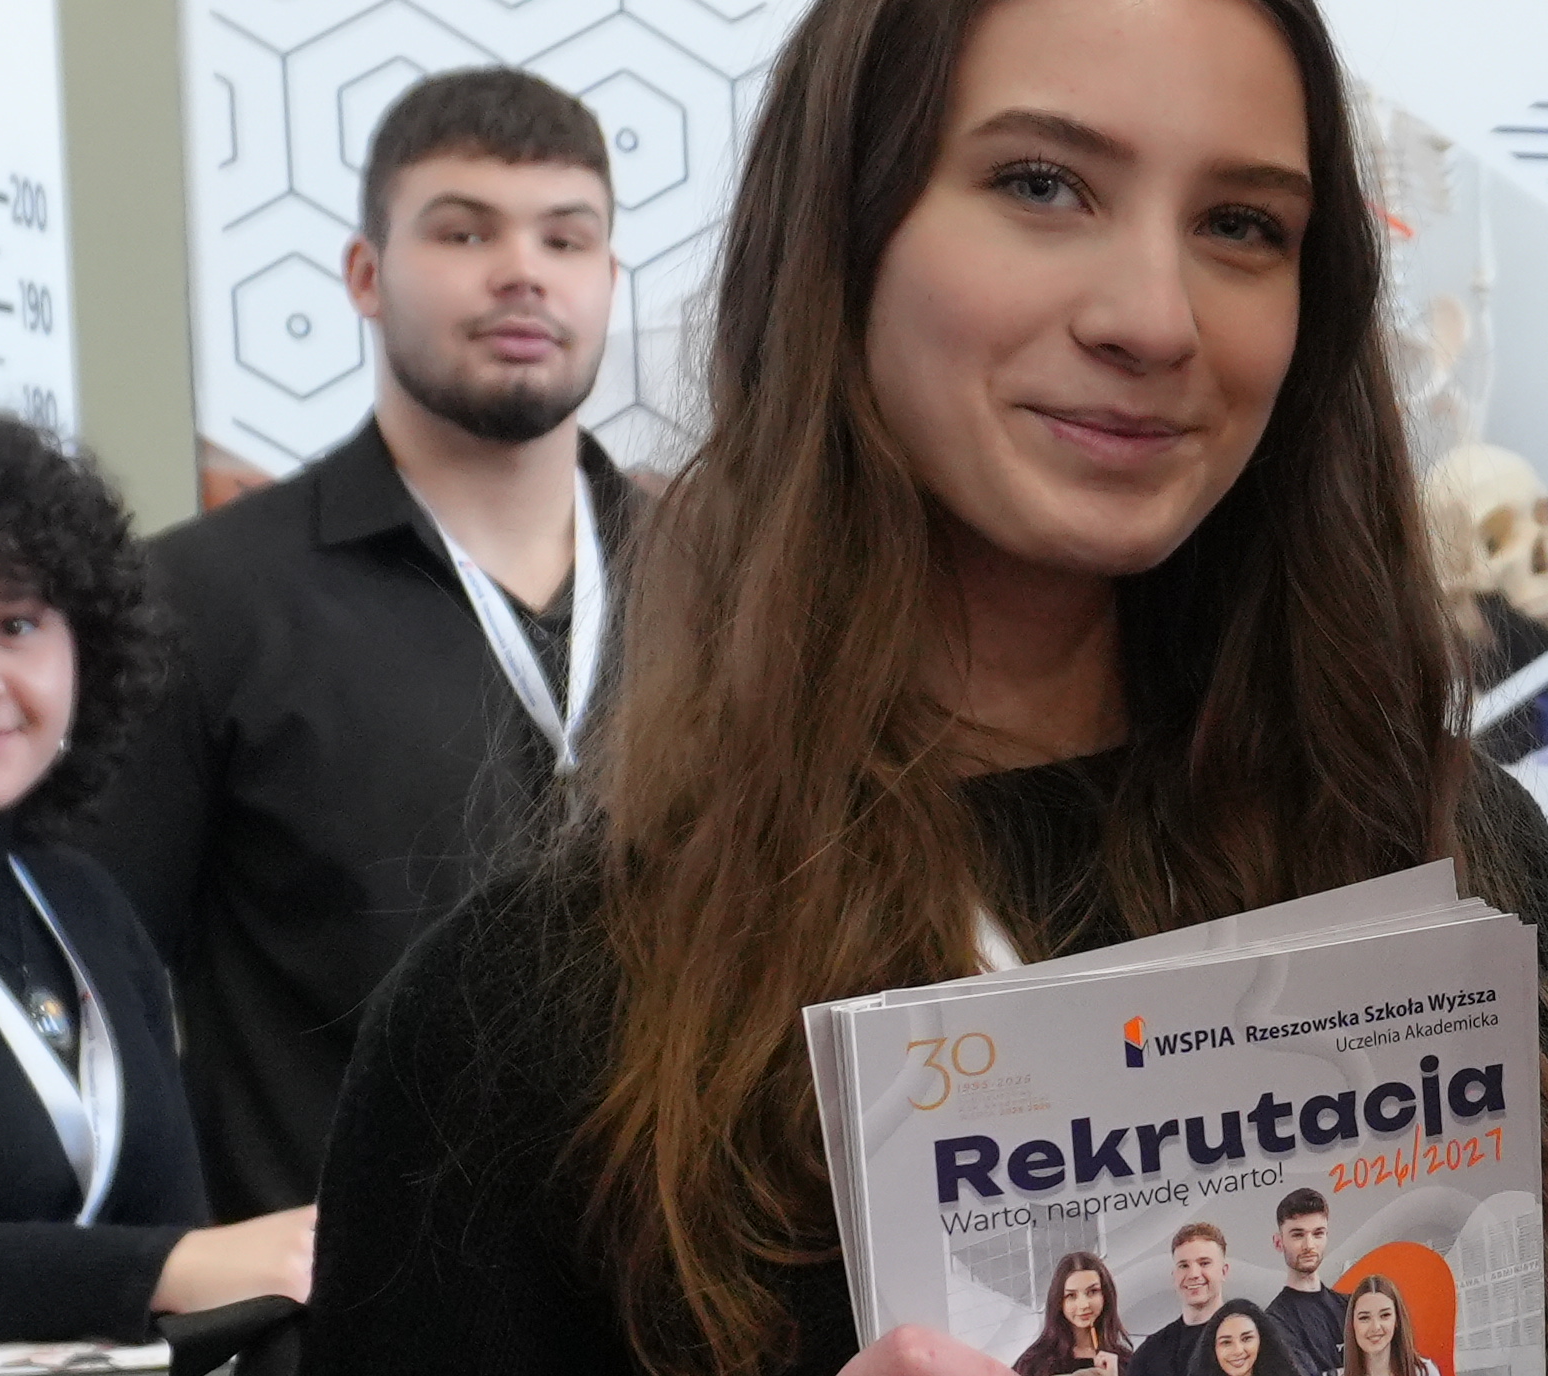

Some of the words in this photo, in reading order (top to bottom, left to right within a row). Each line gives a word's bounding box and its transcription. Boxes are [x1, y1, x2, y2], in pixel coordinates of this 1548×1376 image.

[9, 173, 49, 233] 200
[18, 279, 54, 337] 190
[1155, 1026, 1235, 1057] WSPIA
[1245, 1008, 1360, 1044] Rzeszowska
[1364, 998, 1425, 1026] Szkoła
[1427, 986, 1498, 1019] Wyższa
[1335, 1028, 1402, 1056] Uczelnia
[1405, 1010, 1500, 1043] Akademicka
[905, 1032, 997, 1111] 30
[934, 1054, 1506, 1204] Rekrutacja
[1328, 1124, 1505, 1194] 2026/2027
[941, 1206, 1038, 1238] Warto,
[1046, 1176, 1190, 1223] naprawdę
[1198, 1161, 1285, 1199] warto!
